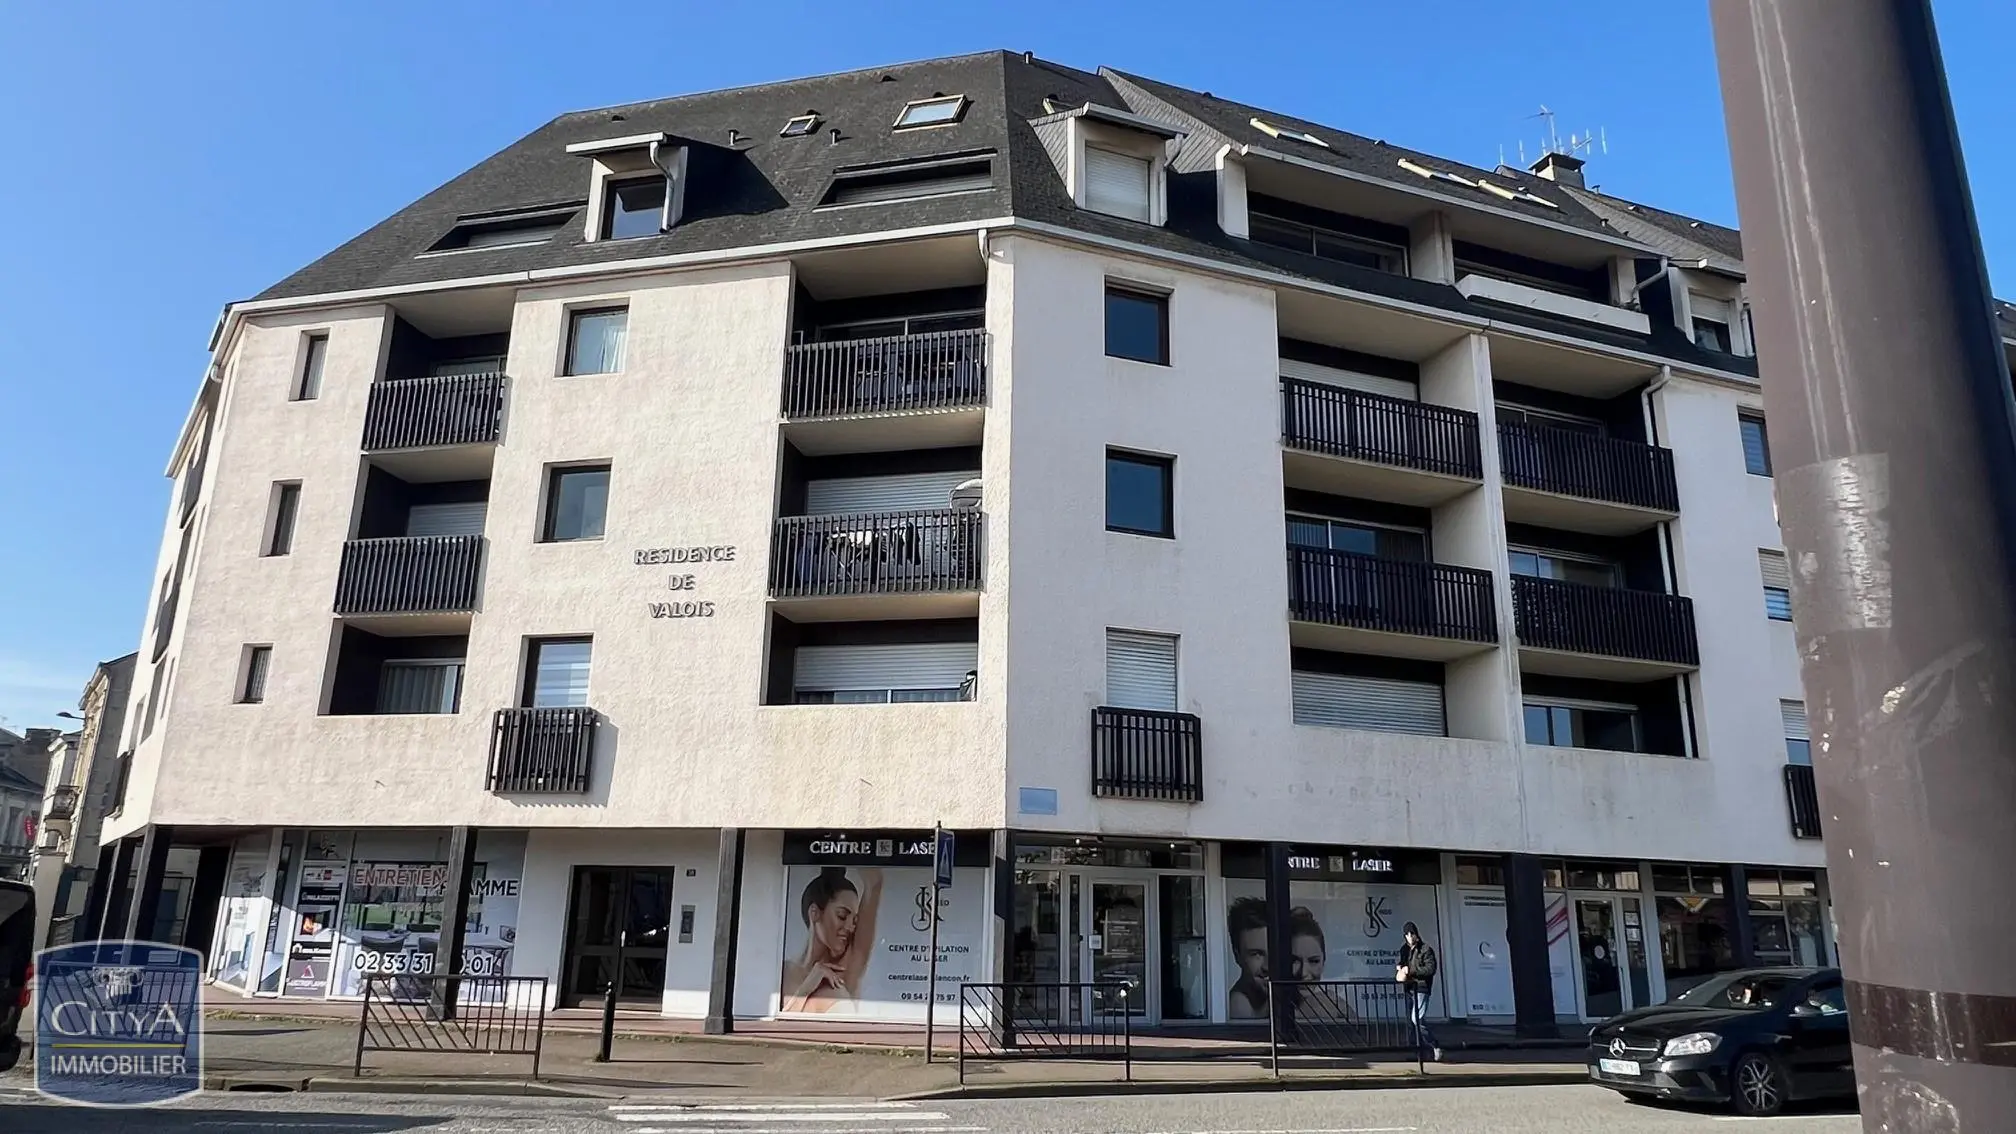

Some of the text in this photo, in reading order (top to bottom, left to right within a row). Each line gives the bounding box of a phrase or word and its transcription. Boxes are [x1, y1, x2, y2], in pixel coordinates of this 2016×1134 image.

[634, 546, 736, 565] RESIDENCE
[668, 574, 696, 591] DE
[648, 601, 716, 618] VALOIS
[809, 840, 871, 855] CENTRE
[899, 841, 936, 856] LASE
[1352, 859, 1393, 872] LASER
[353, 867, 446, 887] ENTRETIEN
[888, 944, 919, 953] CENTRE
[355, 953, 380, 971] 02
[384, 954, 407, 972] 33
[412, 954, 433, 972] 31
[470, 956, 493, 974] 01
[910, 954, 922, 962] AU
